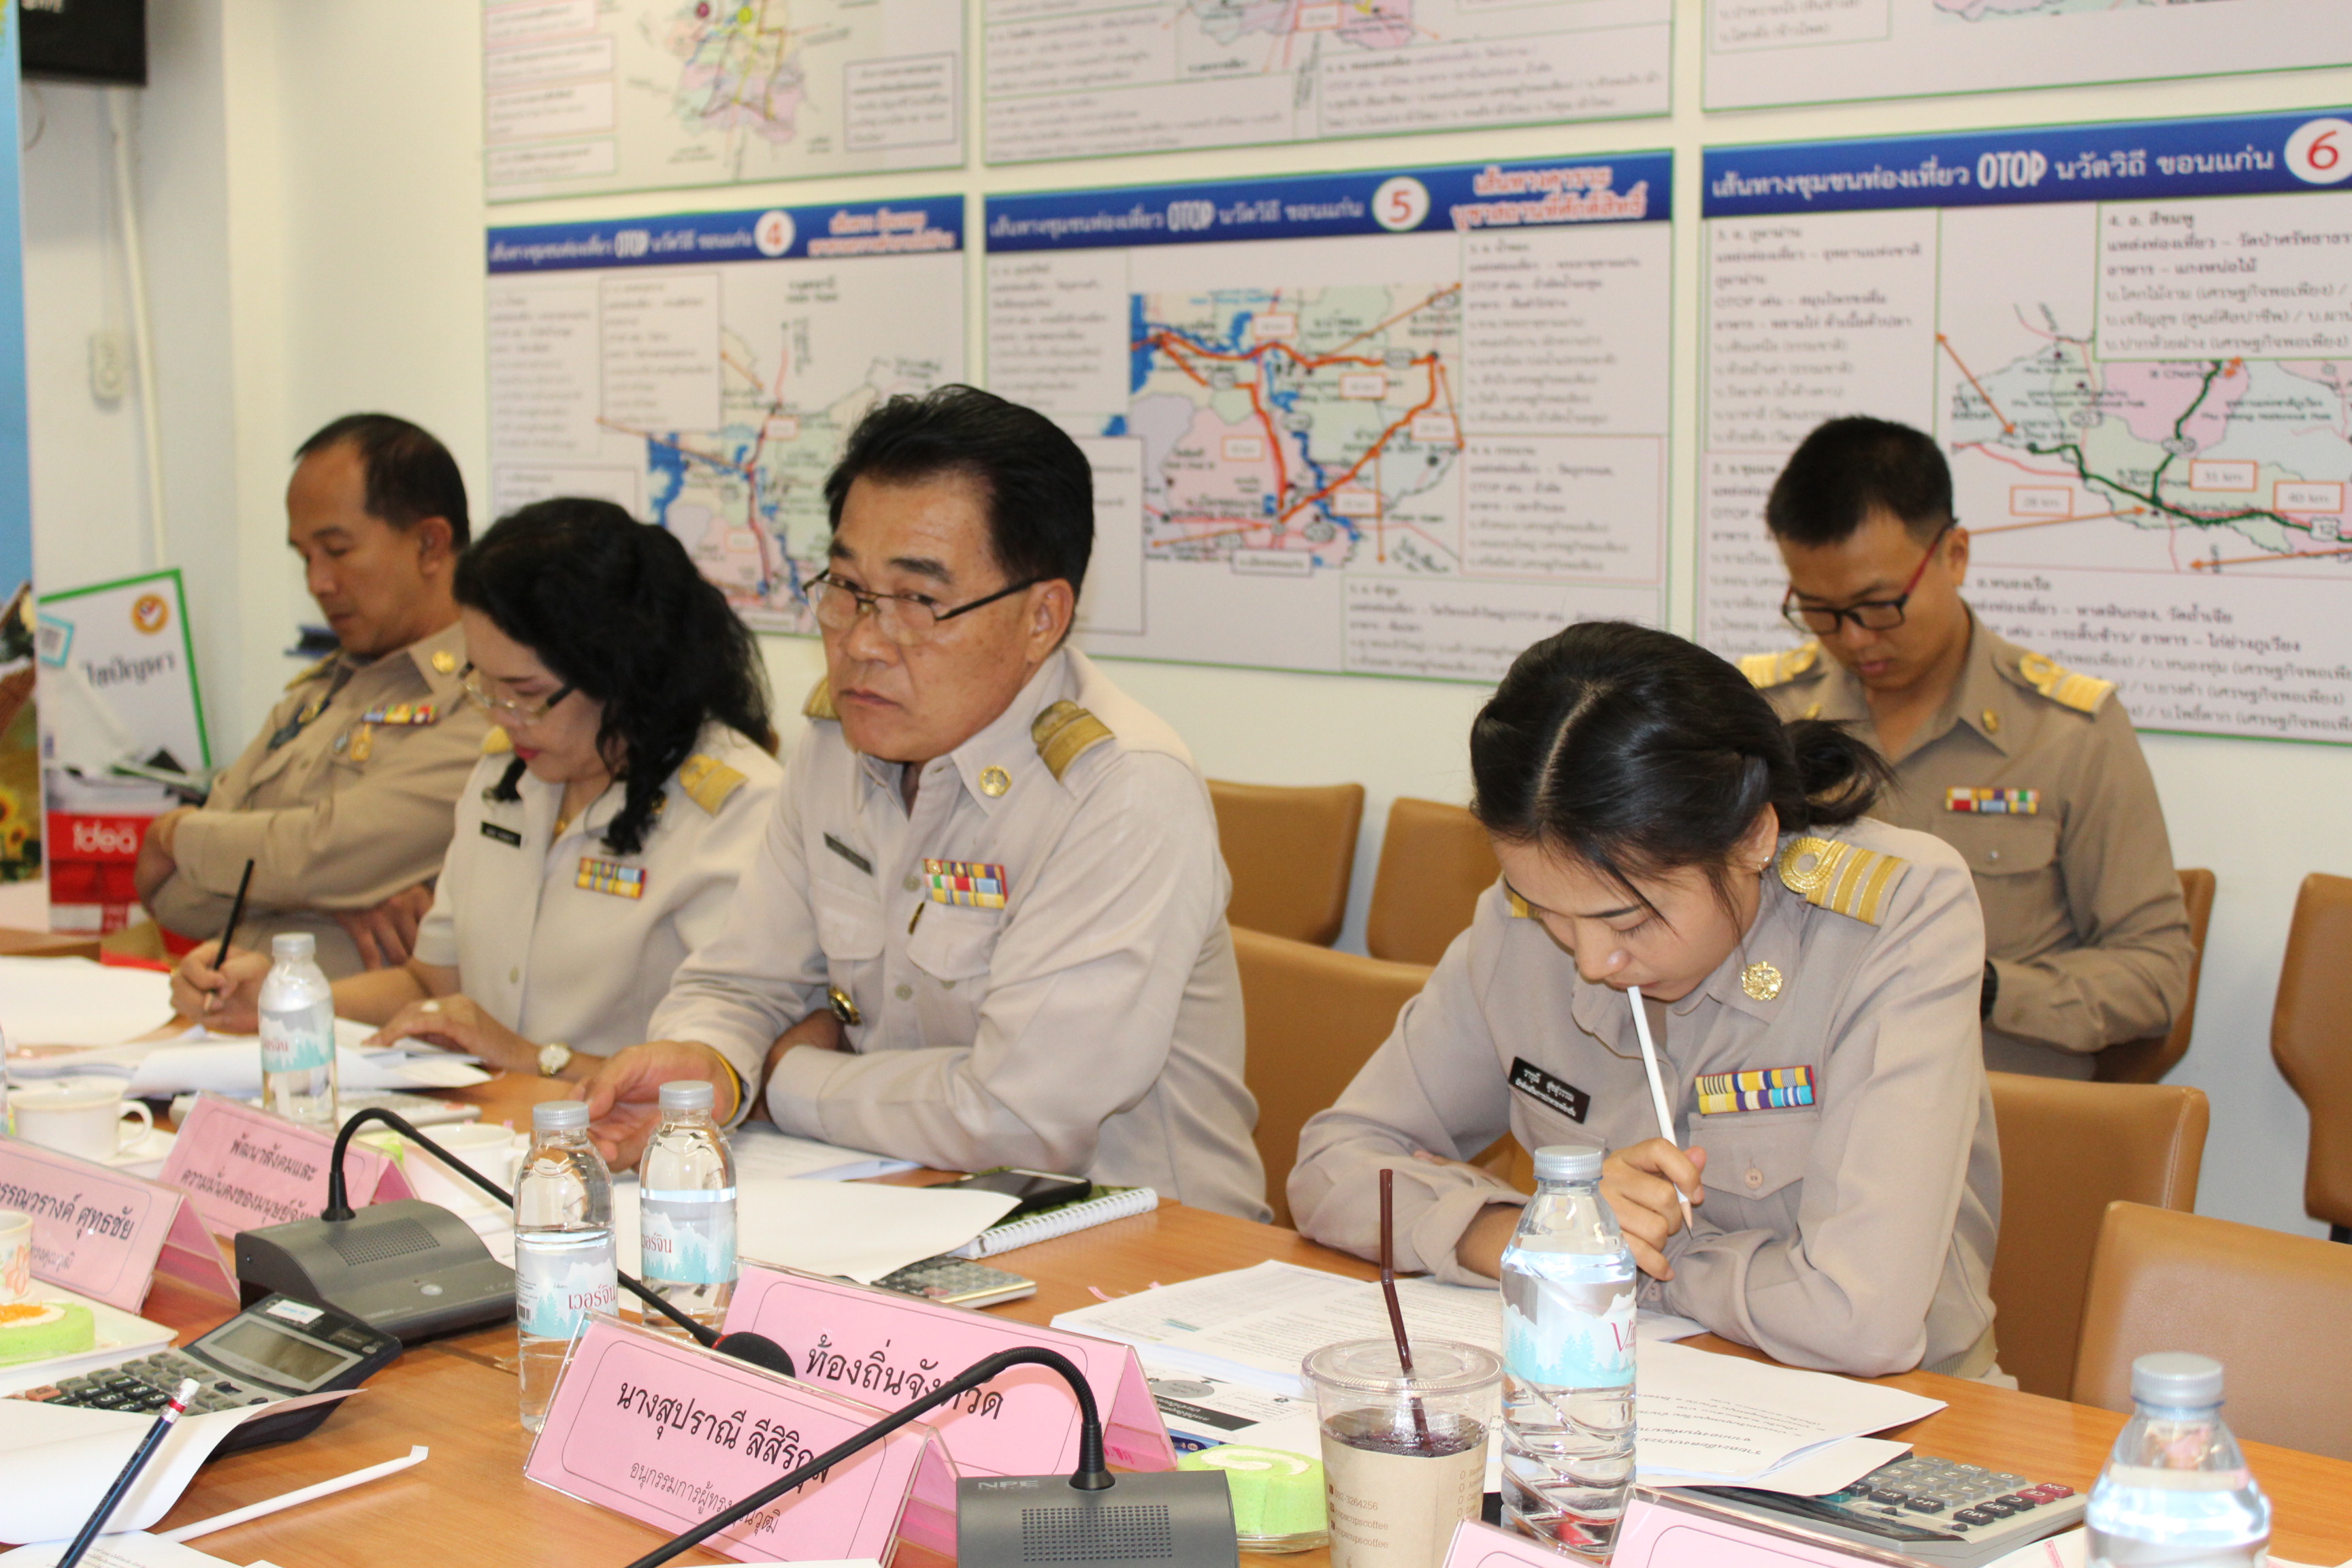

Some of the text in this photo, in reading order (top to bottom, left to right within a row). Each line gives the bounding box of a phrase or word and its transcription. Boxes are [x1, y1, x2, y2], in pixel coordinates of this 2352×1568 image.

[1712, 130, 2338, 201] เส้นทางชุมชนท่องเที่ยว OTOP นวัตวิถี ขอนแก่น 6
[1167, 200, 1215, 231] OTOP
[1285, 196, 1365, 222] ขอนแก่น
[1388, 189, 1411, 223] 5
[2149, 211, 2194, 229] สีชมพู
[615, 230, 649, 257] OTOP
[766, 222, 781, 246] 4
[2107, 233, 2216, 252] แหล่งท่องเที่ยว
[2107, 264, 2155, 277] อาหาร
[2140, 633, 2188, 646] อาหาร
[230, 1132, 318, 1181] พัฒนาสังคมและ
[180, 1166, 325, 1224] ความมั่นคงของมนุษย์จั
[568, 1284, 616, 1310] เวอร์จิน
[806, 1334, 1003, 1420] ท้องถิ่นจังวด
[617, 1382, 747, 1450] นางสุปราณี
[978, 1480, 1039, 1490] NPE
[2043, 1483, 2067, 1492] ON
[1914, 1497, 1938, 1507] M+
[1983, 1503, 2008, 1512] OFF
[1962, 1509, 1987, 1518] MU
